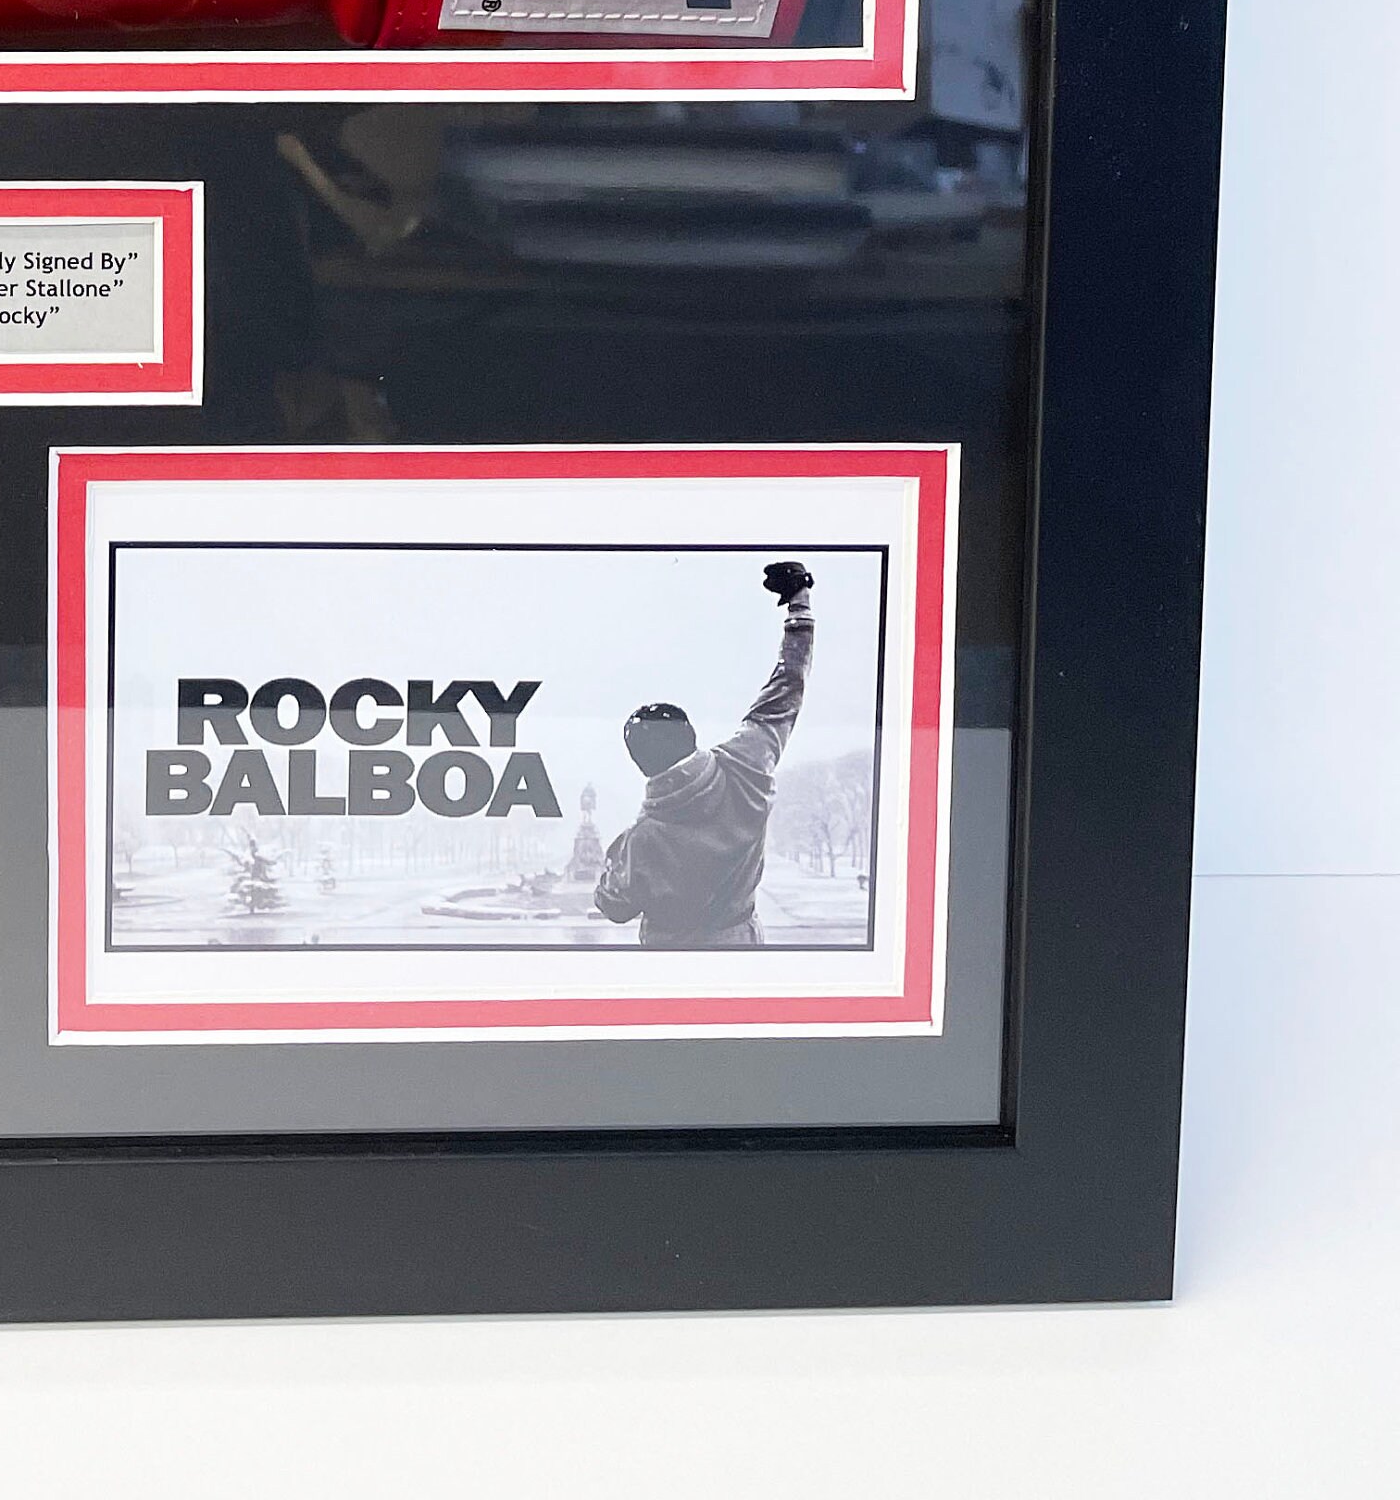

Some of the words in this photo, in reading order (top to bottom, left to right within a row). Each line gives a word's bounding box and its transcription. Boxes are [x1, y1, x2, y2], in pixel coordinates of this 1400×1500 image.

[23, 251, 93, 274] Signed
[25, 279, 124, 298] Stallone”
[177, 677, 543, 747] ROCKY
[145, 749, 563, 818] BALBOA
